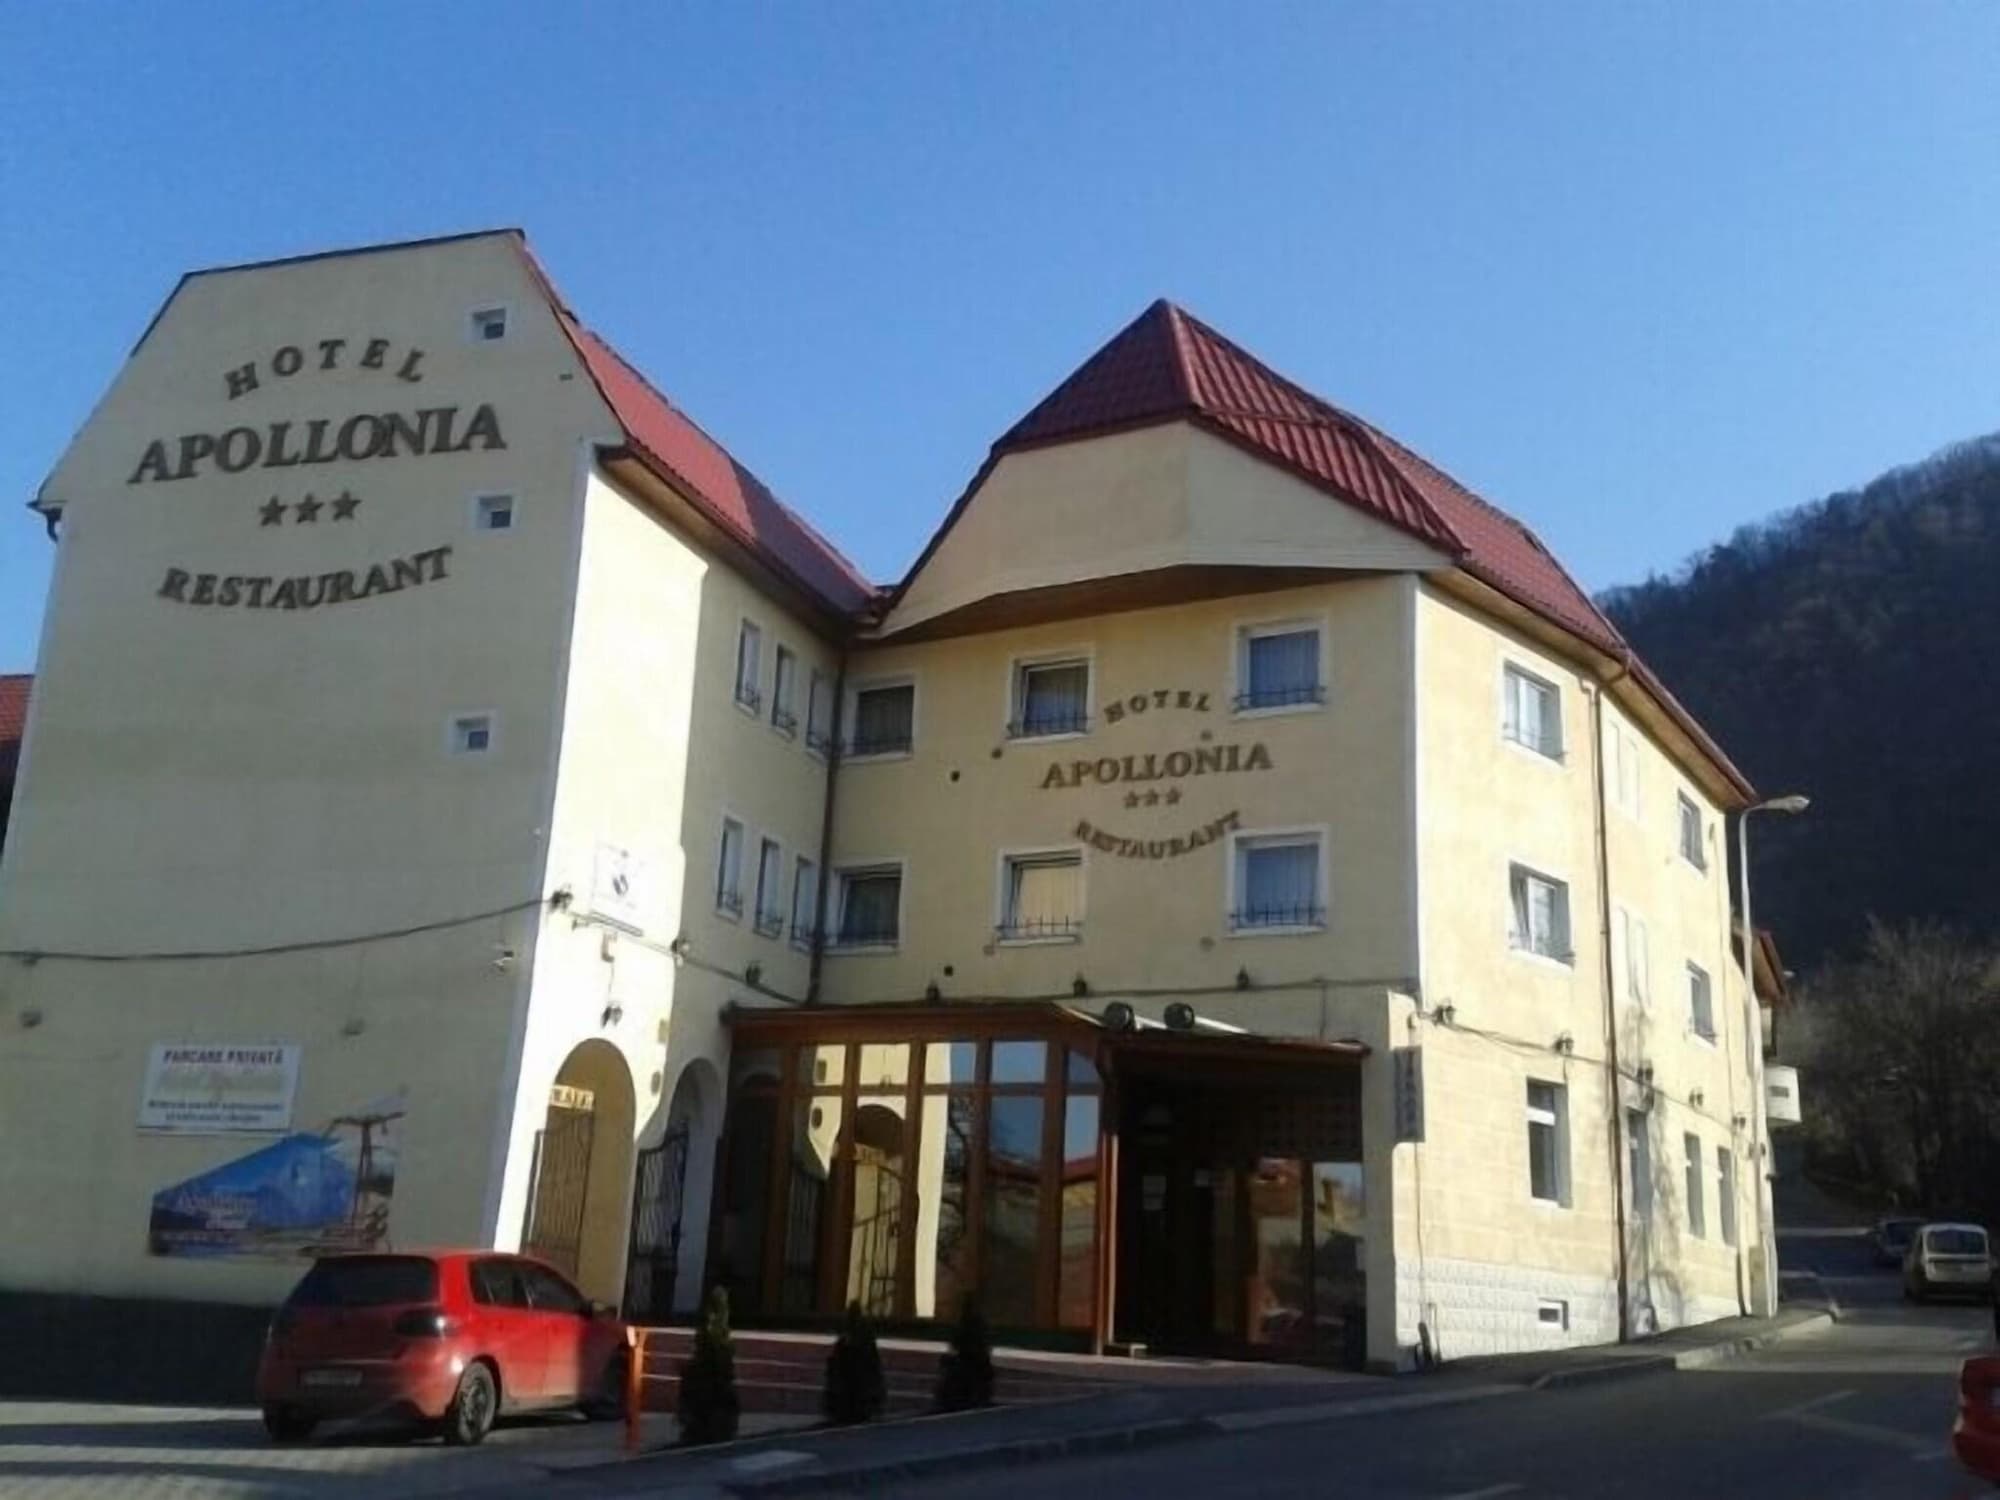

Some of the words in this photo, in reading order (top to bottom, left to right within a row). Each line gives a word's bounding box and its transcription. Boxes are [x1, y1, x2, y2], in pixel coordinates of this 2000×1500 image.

[224, 338, 425, 399] HOTEL
[126, 403, 507, 484] APOLLONIA
[156, 546, 453, 610] RESTAURANT
[1104, 689, 1210, 724] HOTEL
[1041, 743, 1272, 788] APOLLONIA
[1074, 810, 1241, 859] RESTAURANT
